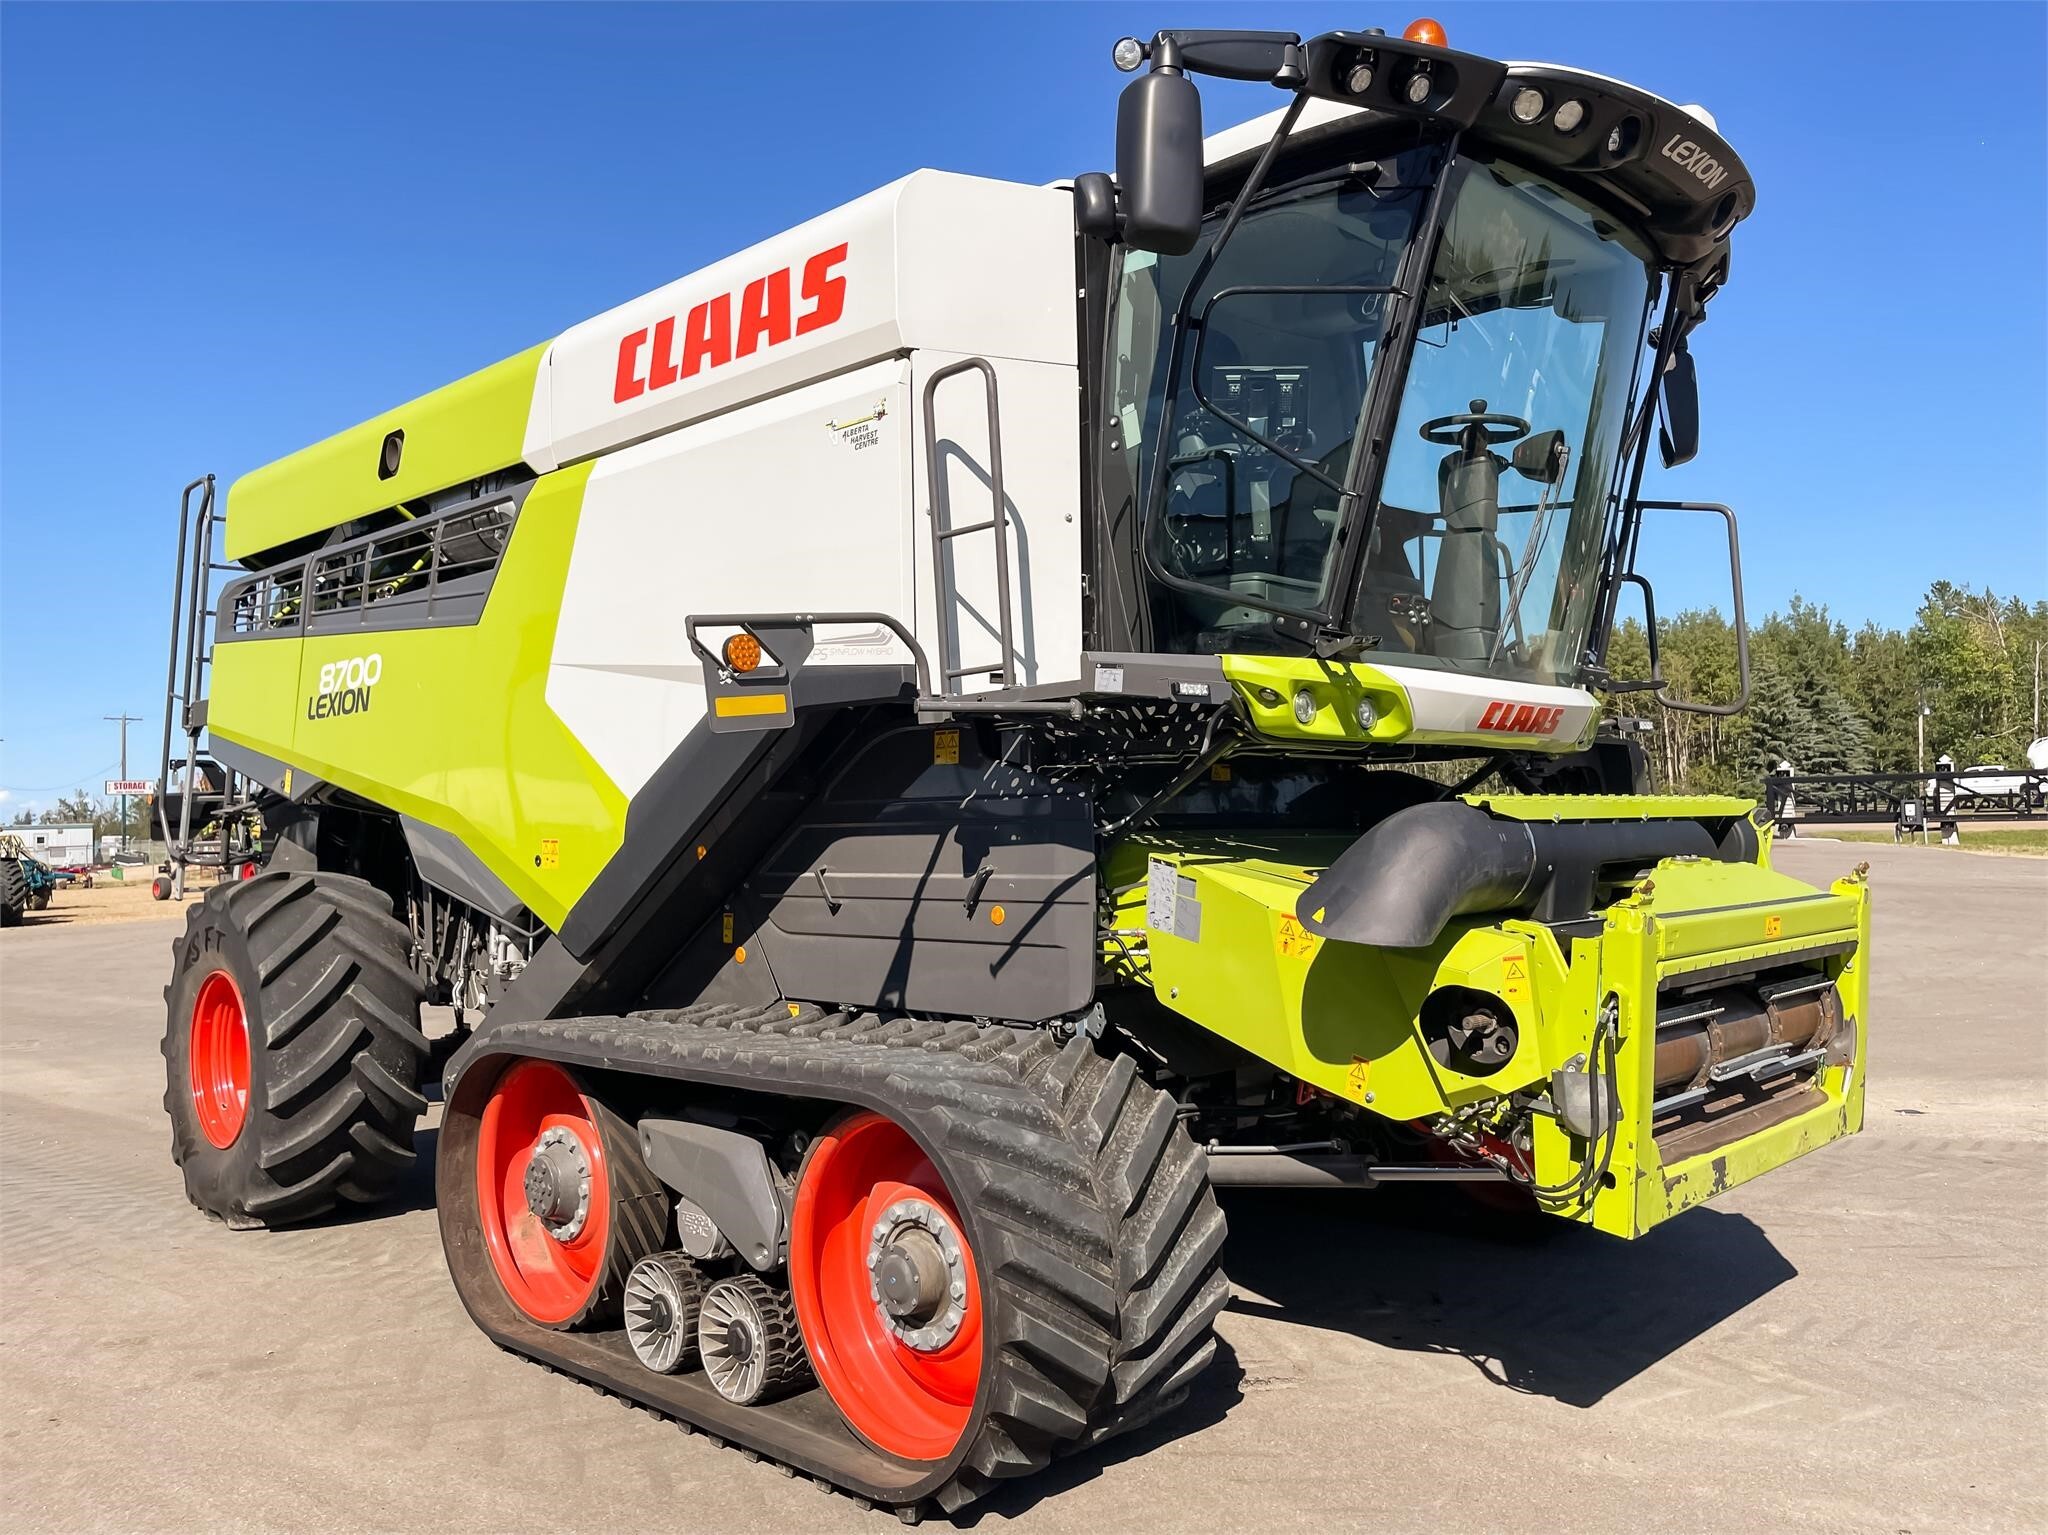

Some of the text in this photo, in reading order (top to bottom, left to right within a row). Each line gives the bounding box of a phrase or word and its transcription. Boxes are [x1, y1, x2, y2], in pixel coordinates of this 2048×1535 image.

[1662, 134, 1728, 189] LEXION
[614, 242, 848, 404] CLAAS
[843, 424, 869, 442] ALBERTA
[850, 430, 877, 444] HARVEST
[855, 437, 878, 451] CENTRE
[319, 653, 383, 694] 8700
[308, 686, 371, 720] LEXION
[1477, 701, 1565, 735] CLAAS
[113, 782, 146, 791] STORAGE
